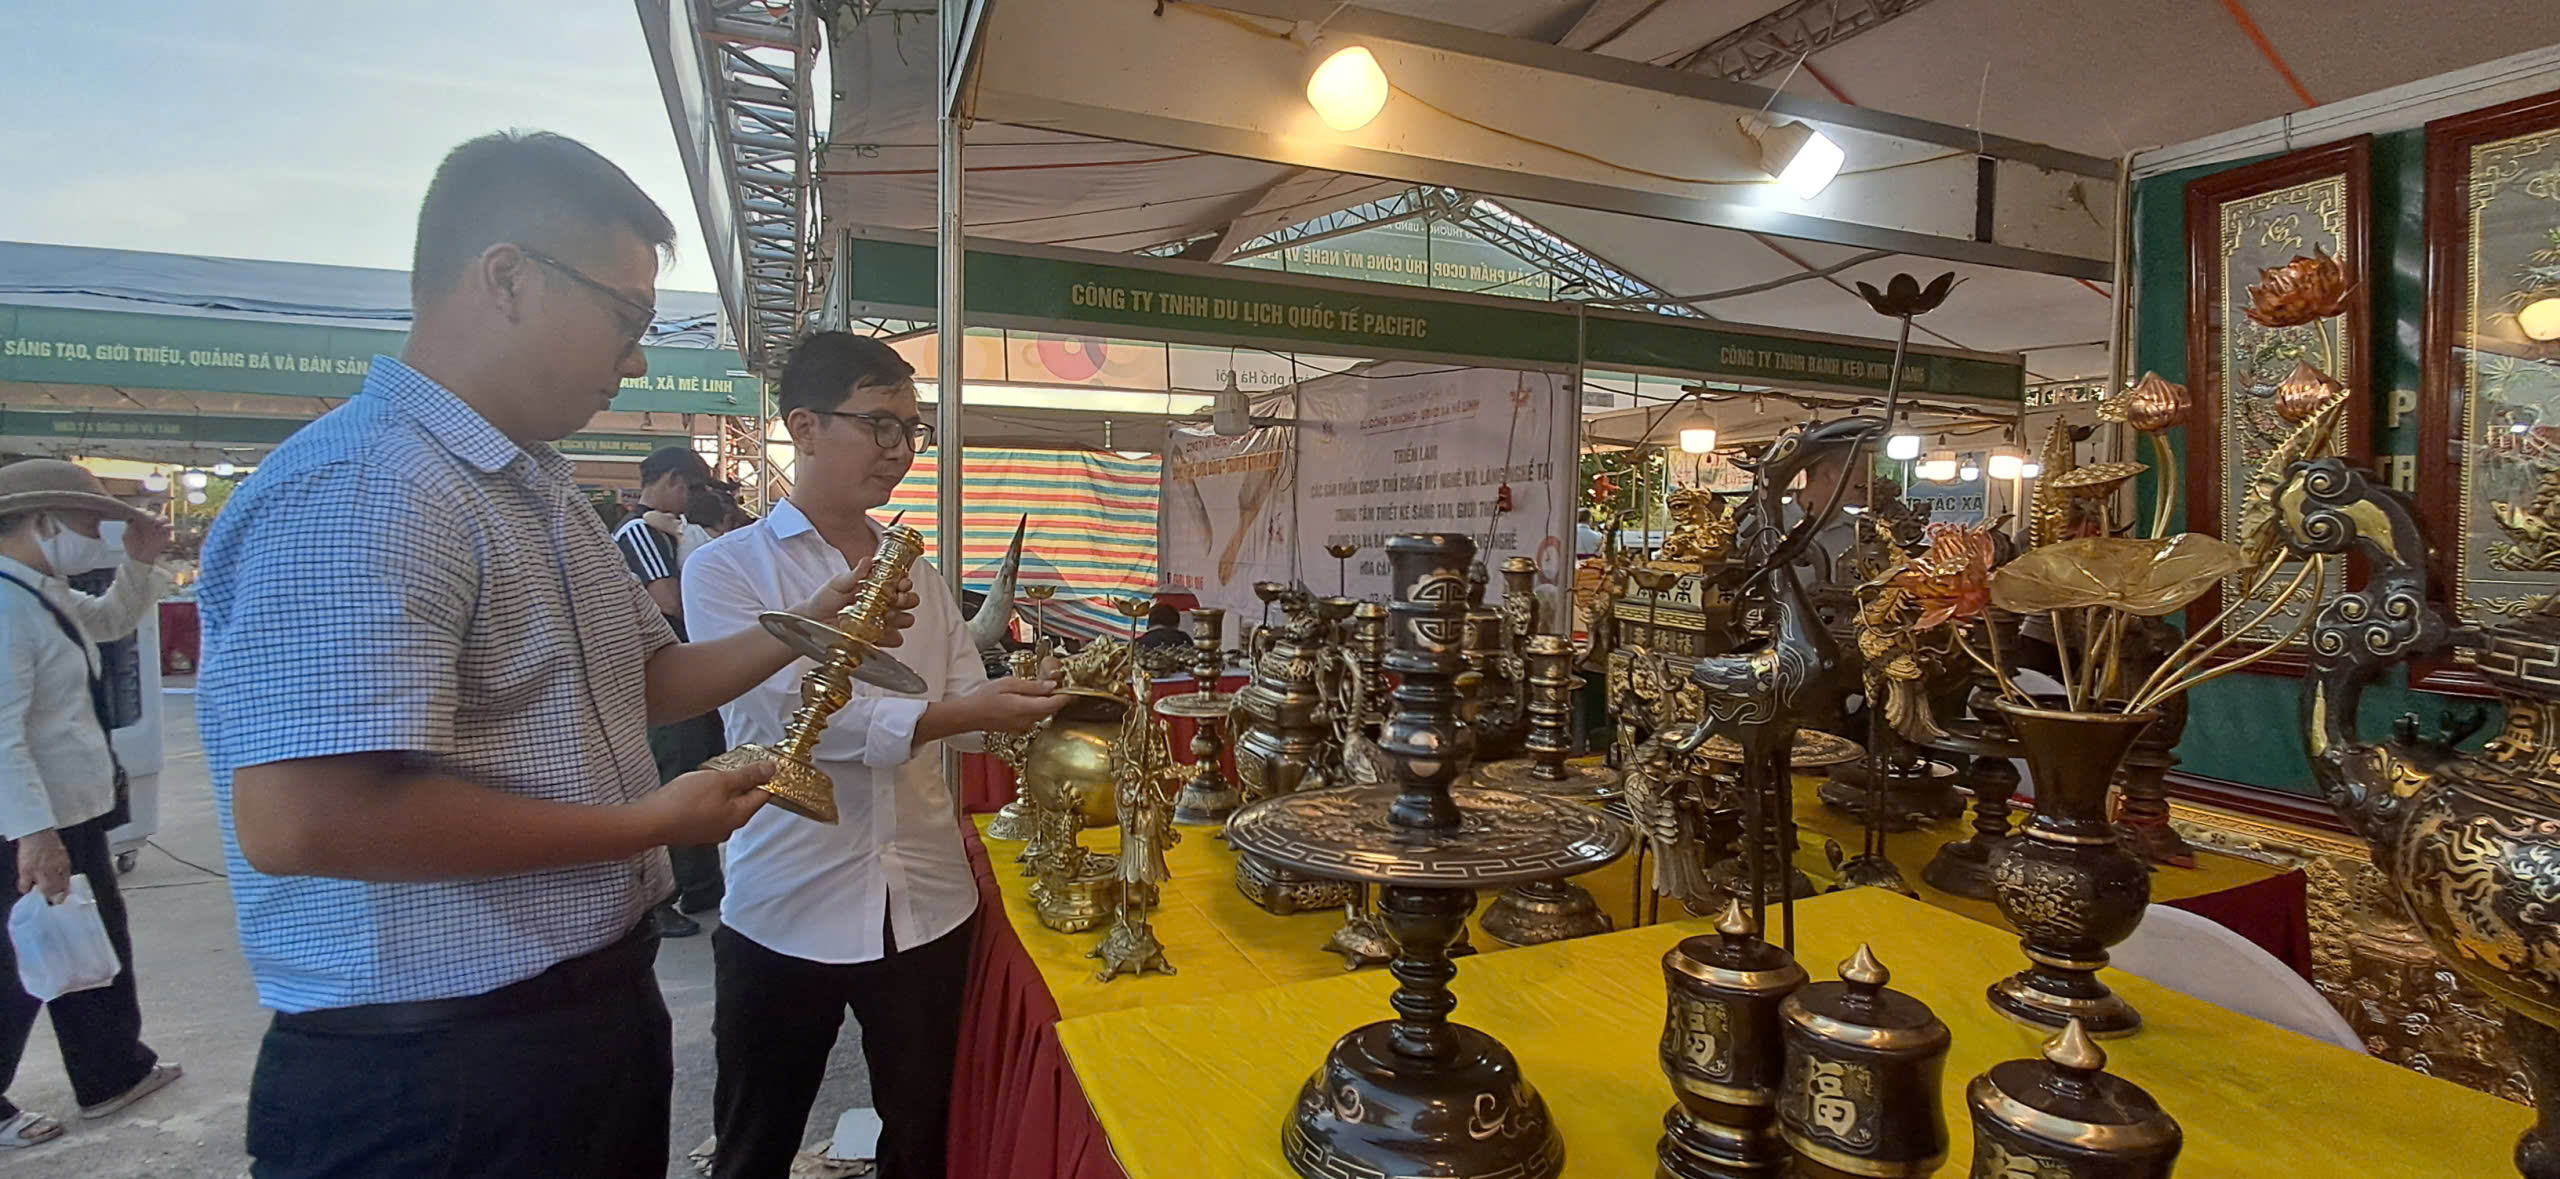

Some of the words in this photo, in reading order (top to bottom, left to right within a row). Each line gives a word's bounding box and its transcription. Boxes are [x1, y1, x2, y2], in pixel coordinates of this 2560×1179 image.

[1072, 281, 1125, 310] CÔNG
[1130, 290, 1153, 312] TY
[1159, 292, 1208, 318] TNHH
[1214, 298, 1238, 320] DU
[1243, 301, 1283, 327] LỊCH
[1288, 302, 1335, 329] QUỐC
[1339, 306, 1361, 332] TẾ
[1363, 313, 1427, 338] PACIFIC
[5, 337, 52, 358] SÁNG
[55, 343, 91, 361] TẠO,
[95, 343, 130, 361] GIỚI
[133, 345, 185, 366] THIỆU,
[189, 348, 246, 368] QUẢNG
[249, 352, 271, 370] BÁ
[274, 353, 295, 371] VÀ
[299, 355, 332, 374] BÁN
[336, 356, 369, 375] SẢN
[656, 375, 675, 391] XÃ
[678, 375, 699, 391] MÊ
[702, 378, 733, 393] LINH
[1720, 344, 1754, 367] CÔNG
[1758, 351, 1771, 369] TY
[1775, 352, 1805, 372] TNHH
[1928, 493, 1957, 512] TÁC
[1961, 491, 1984, 512] XÃ
